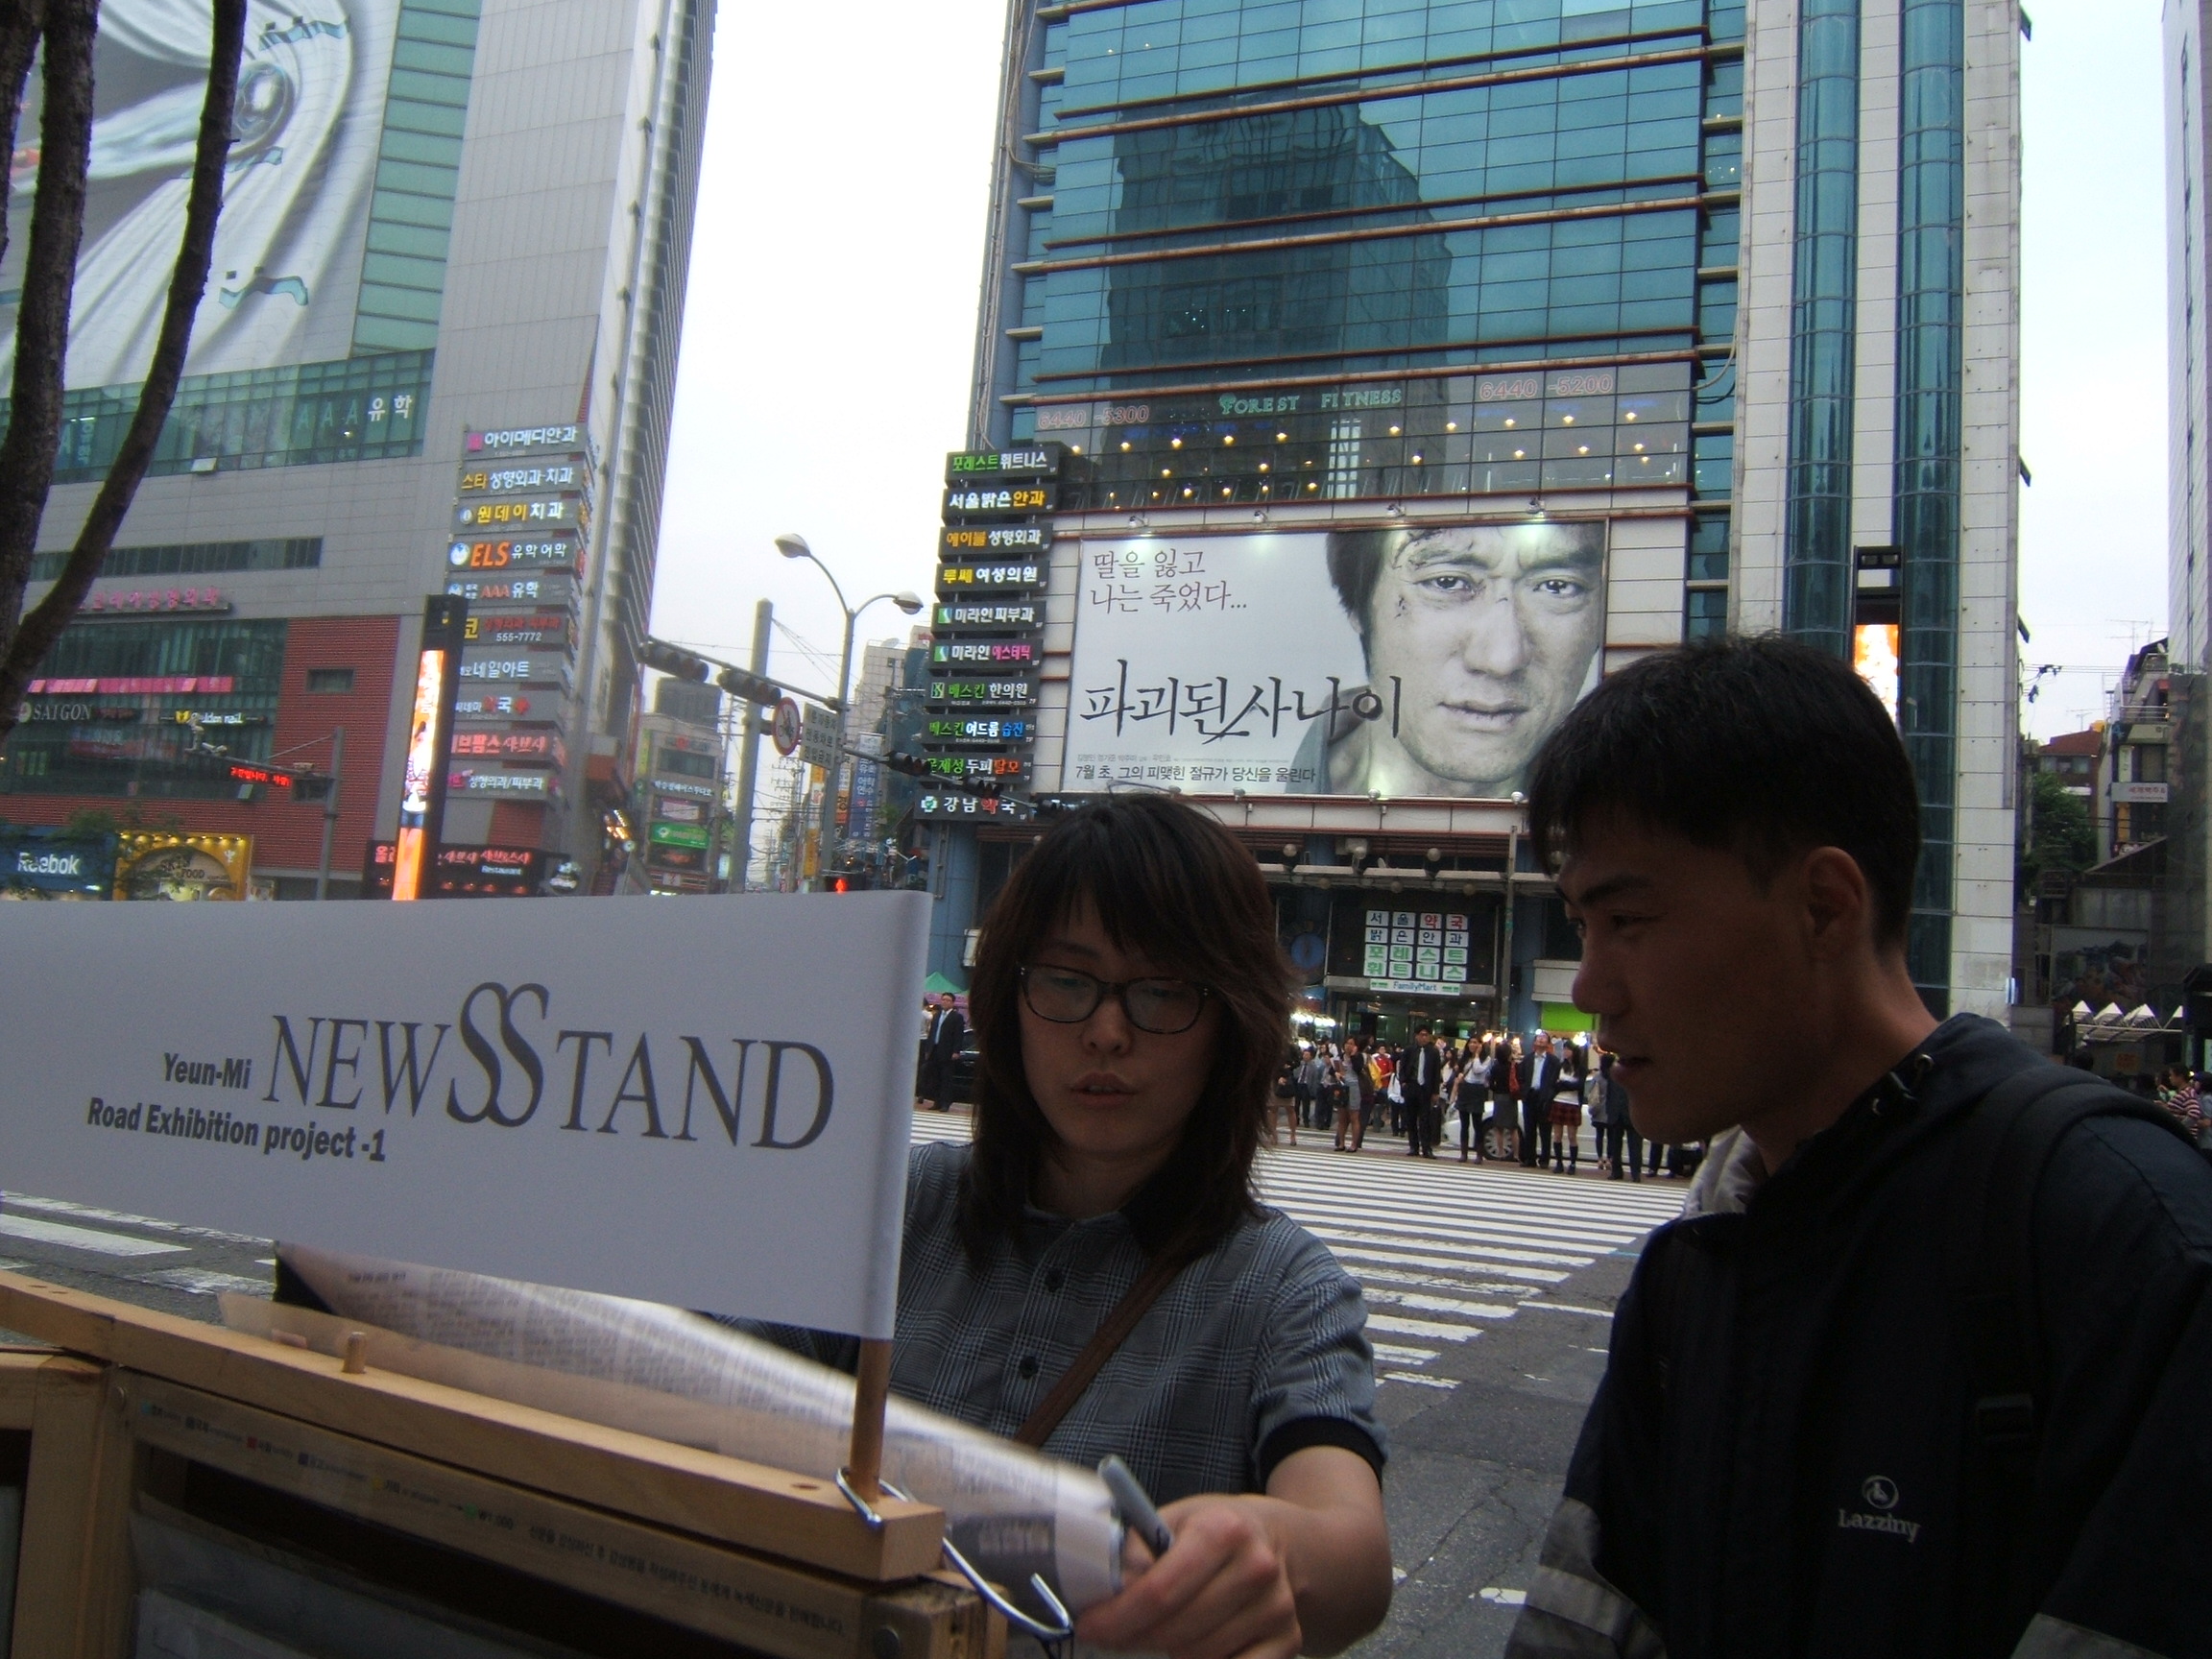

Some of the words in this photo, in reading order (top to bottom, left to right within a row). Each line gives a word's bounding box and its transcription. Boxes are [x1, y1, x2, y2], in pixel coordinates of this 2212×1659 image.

[368, 395, 413, 423] 유학
[1219, 393, 1300, 415] FOREST
[1321, 389, 1402, 408] FITNESS
[485, 425, 578, 448] 아이메디안과
[952, 454, 998, 472] 포레스트
[1000, 451, 1047, 470] 휘트니스
[461, 472, 488, 490] 스타
[950, 491, 1011, 510] 서울밝은
[1013, 490, 1046, 508] 안과
[477, 504, 527, 524] 원데이
[530, 501, 565, 519] 치과
[989, 528, 1042, 547] 성형외과
[470, 541, 510, 567] ELS
[1094, 551, 1145, 579] 딸을
[1154, 548, 1206, 578] 잃고
[976, 565, 1038, 584] 여성의원
[1091, 584, 1143, 613] 나는
[1150, 579, 1247, 613] 죽었다...
[955, 608, 993, 623] 미라인
[995, 607, 1035, 622] 피부과
[496, 632, 541, 642] 555-7772
[951, 644, 990, 661] 미라인
[988, 683, 1028, 699] 한의원
[1079, 659, 1250, 739] 파괴된
[1219, 676, 1402, 741] 사나이
[33, 704, 93, 720] SAIGON
[966, 721, 999, 737] 여드름
[1001, 721, 1023, 738] 습진
[965, 757, 994, 775] 두피
[994, 758, 1020, 775] 탈모
[1076, 764, 1095, 781] 7월
[1118, 765, 1143, 781] 그의
[1190, 765, 1228, 781] 절규가
[1233, 766, 1272, 782] 당신을
[1276, 767, 1315, 783] 울린다
[17, 852, 80, 876] Reebok
[1370, 912, 1463, 930] 서울약국
[1369, 928, 1463, 946] 밝은안과
[1368, 946, 1464, 962] 포레스트
[1393, 981, 1437, 993] FamilyMart
[164, 1052, 252, 1091] Yeun-Mi
[87, 1096, 143, 1132] Road
[145, 1104, 259, 1147] Exhibition
[263, 1120, 356, 1161] project
